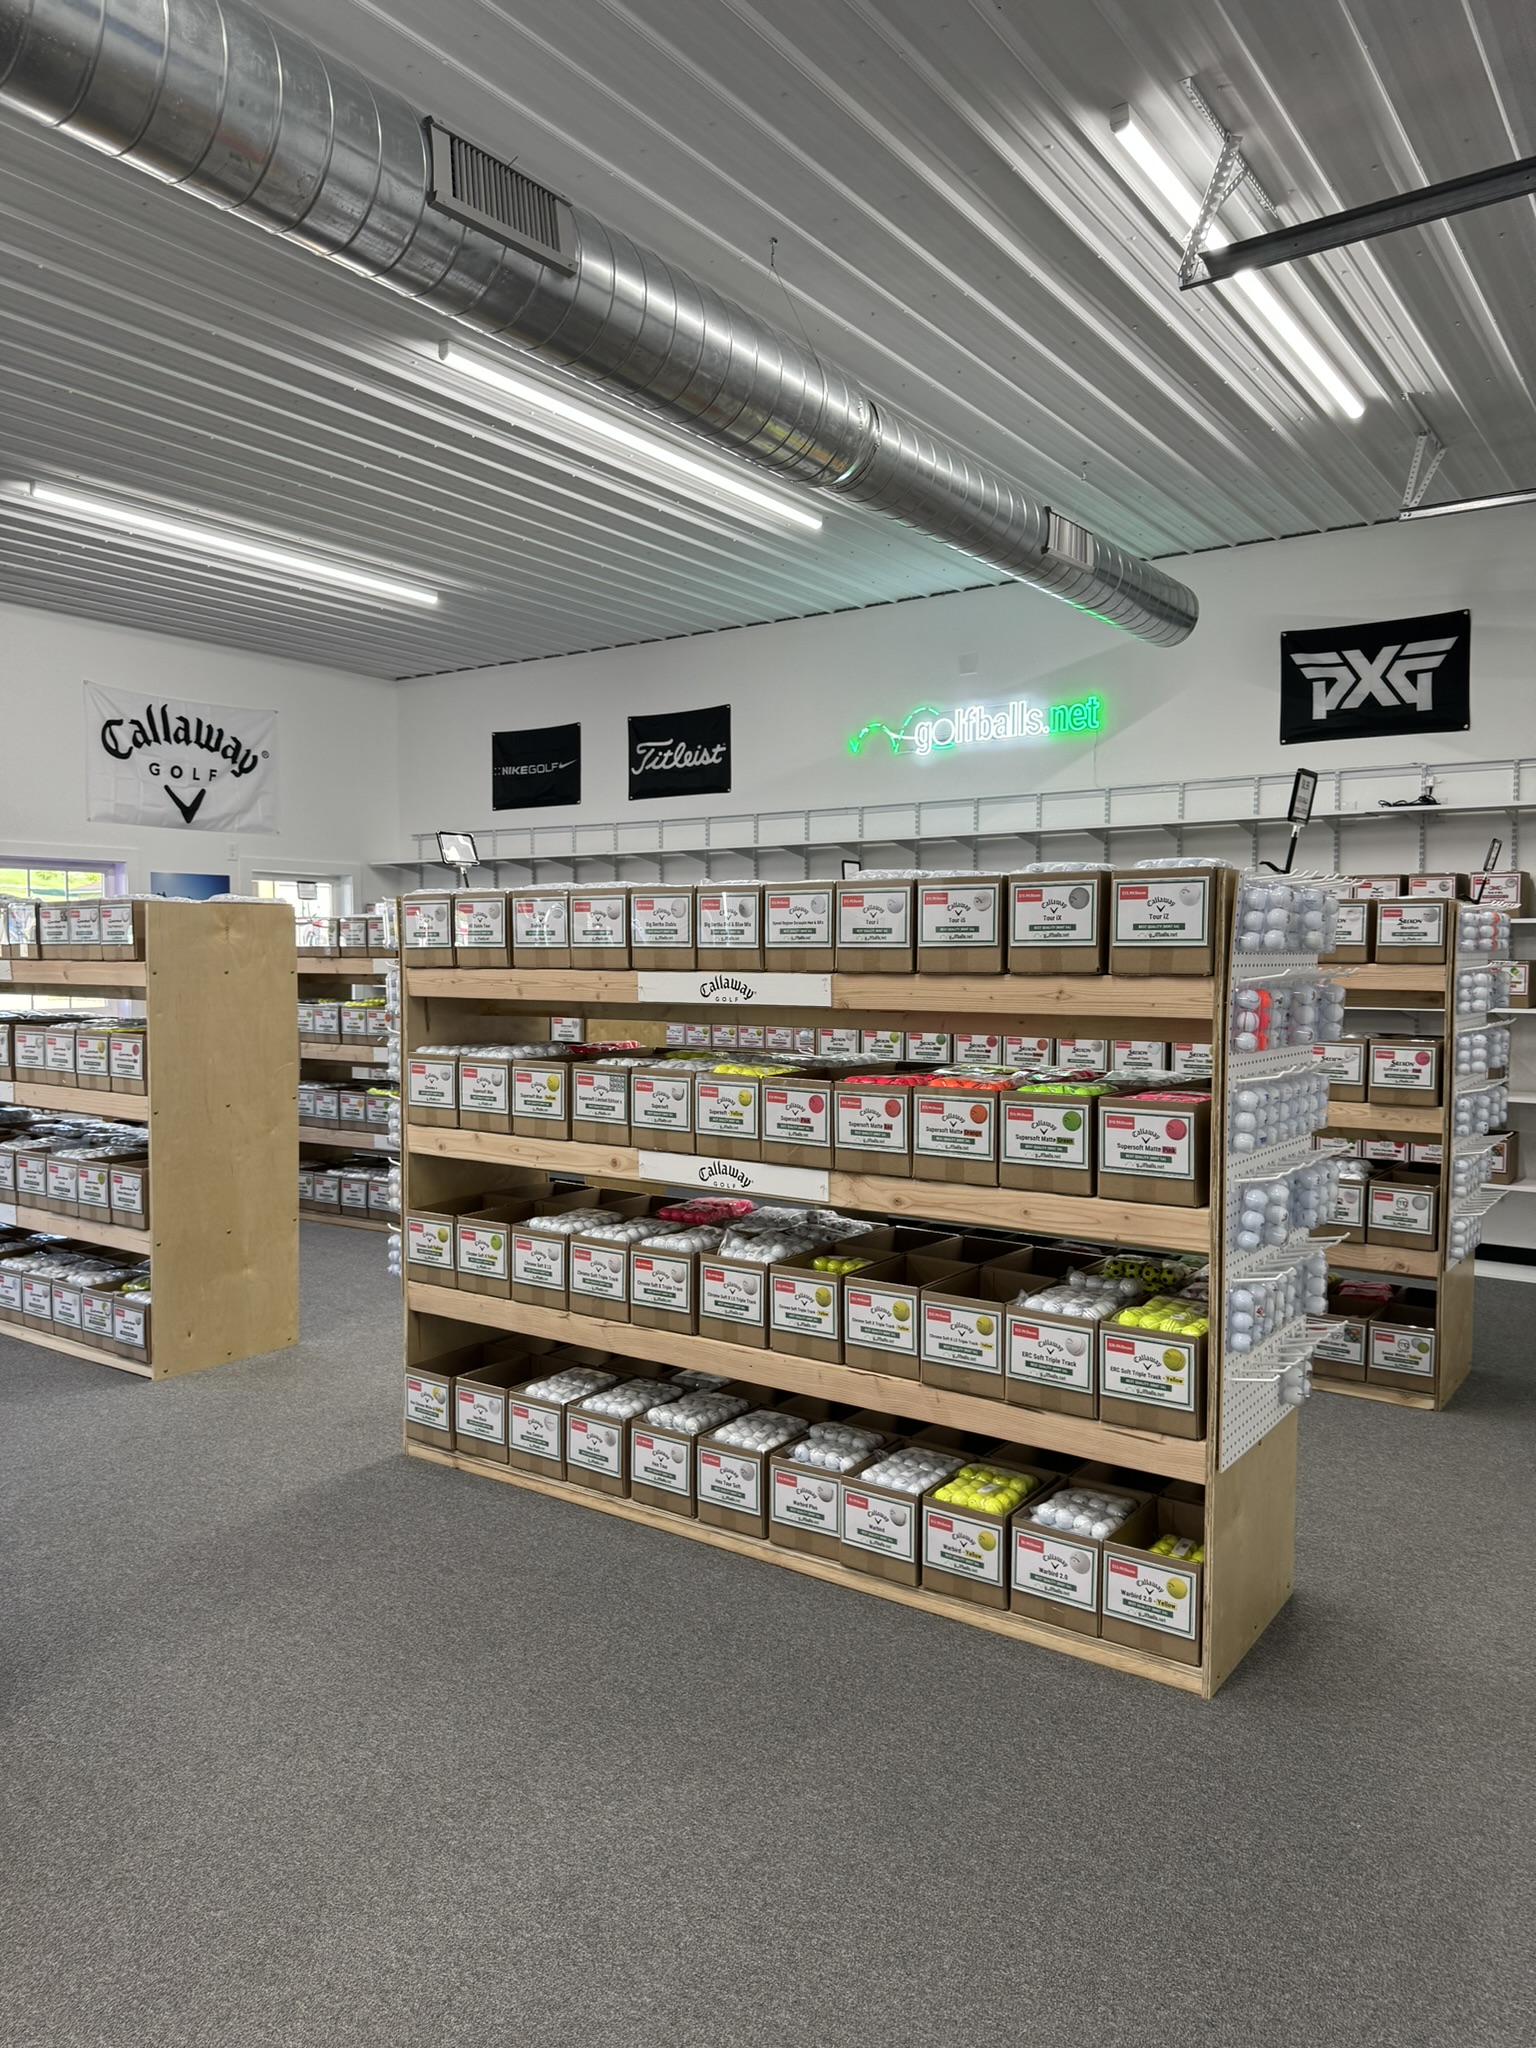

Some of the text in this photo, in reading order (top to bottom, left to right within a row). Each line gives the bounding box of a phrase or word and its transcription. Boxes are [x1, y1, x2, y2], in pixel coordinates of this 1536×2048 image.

[1289, 636, 1459, 720] PXG
[914, 696, 1100, 756] golfballs.net
[101, 704, 258, 778] Callaway
[631, 738, 723, 775] Titleist
[149, 762, 217, 781] GOLF
[947, 902, 971, 912] Callaway
[1041, 898, 1068, 909] Callaway
[1146, 896, 1176, 907] Callaway
[700, 974, 754, 1001] Callaway
[780, 1115, 801, 1123] Supersoft
[848, 1121, 869, 1129] Supersoft
[926, 1126, 949, 1134] Supersoft
[1031, 1120, 1058, 1132] Callaway
[1015, 1134, 1041, 1142] Supersoft
[1131, 1128, 1161, 1140] Callaway
[1117, 1142, 1144, 1151] Supersoft
[1145, 1145, 1161, 1153] Matte
[698, 1160, 751, 1188] Callaway
[1038, 1339, 1064, 1352] Callaway
[1022, 1351, 1077, 1368] ERC Soft Triple Track
[1133, 1354, 1162, 1367] Callaway
[1110, 1365, 1120, 1373] ERC
[1132, 1370, 1147, 1378] Triple
[1147, 1372, 1162, 1380] Track
[1166, 1375, 1183, 1384] Yellow
[943, 1543, 962, 1554] Warbird
[1042, 1553, 1069, 1568] Callaway
[1039, 1567, 1069, 1580] Warbird 2.0
[1136, 1578, 1164, 1593] Callaway
[1121, 1588, 1142, 1601] Warbird
[1143, 1595, 1153, 1603] 2.0
[1157, 1599, 1176, 1609] Yellow
